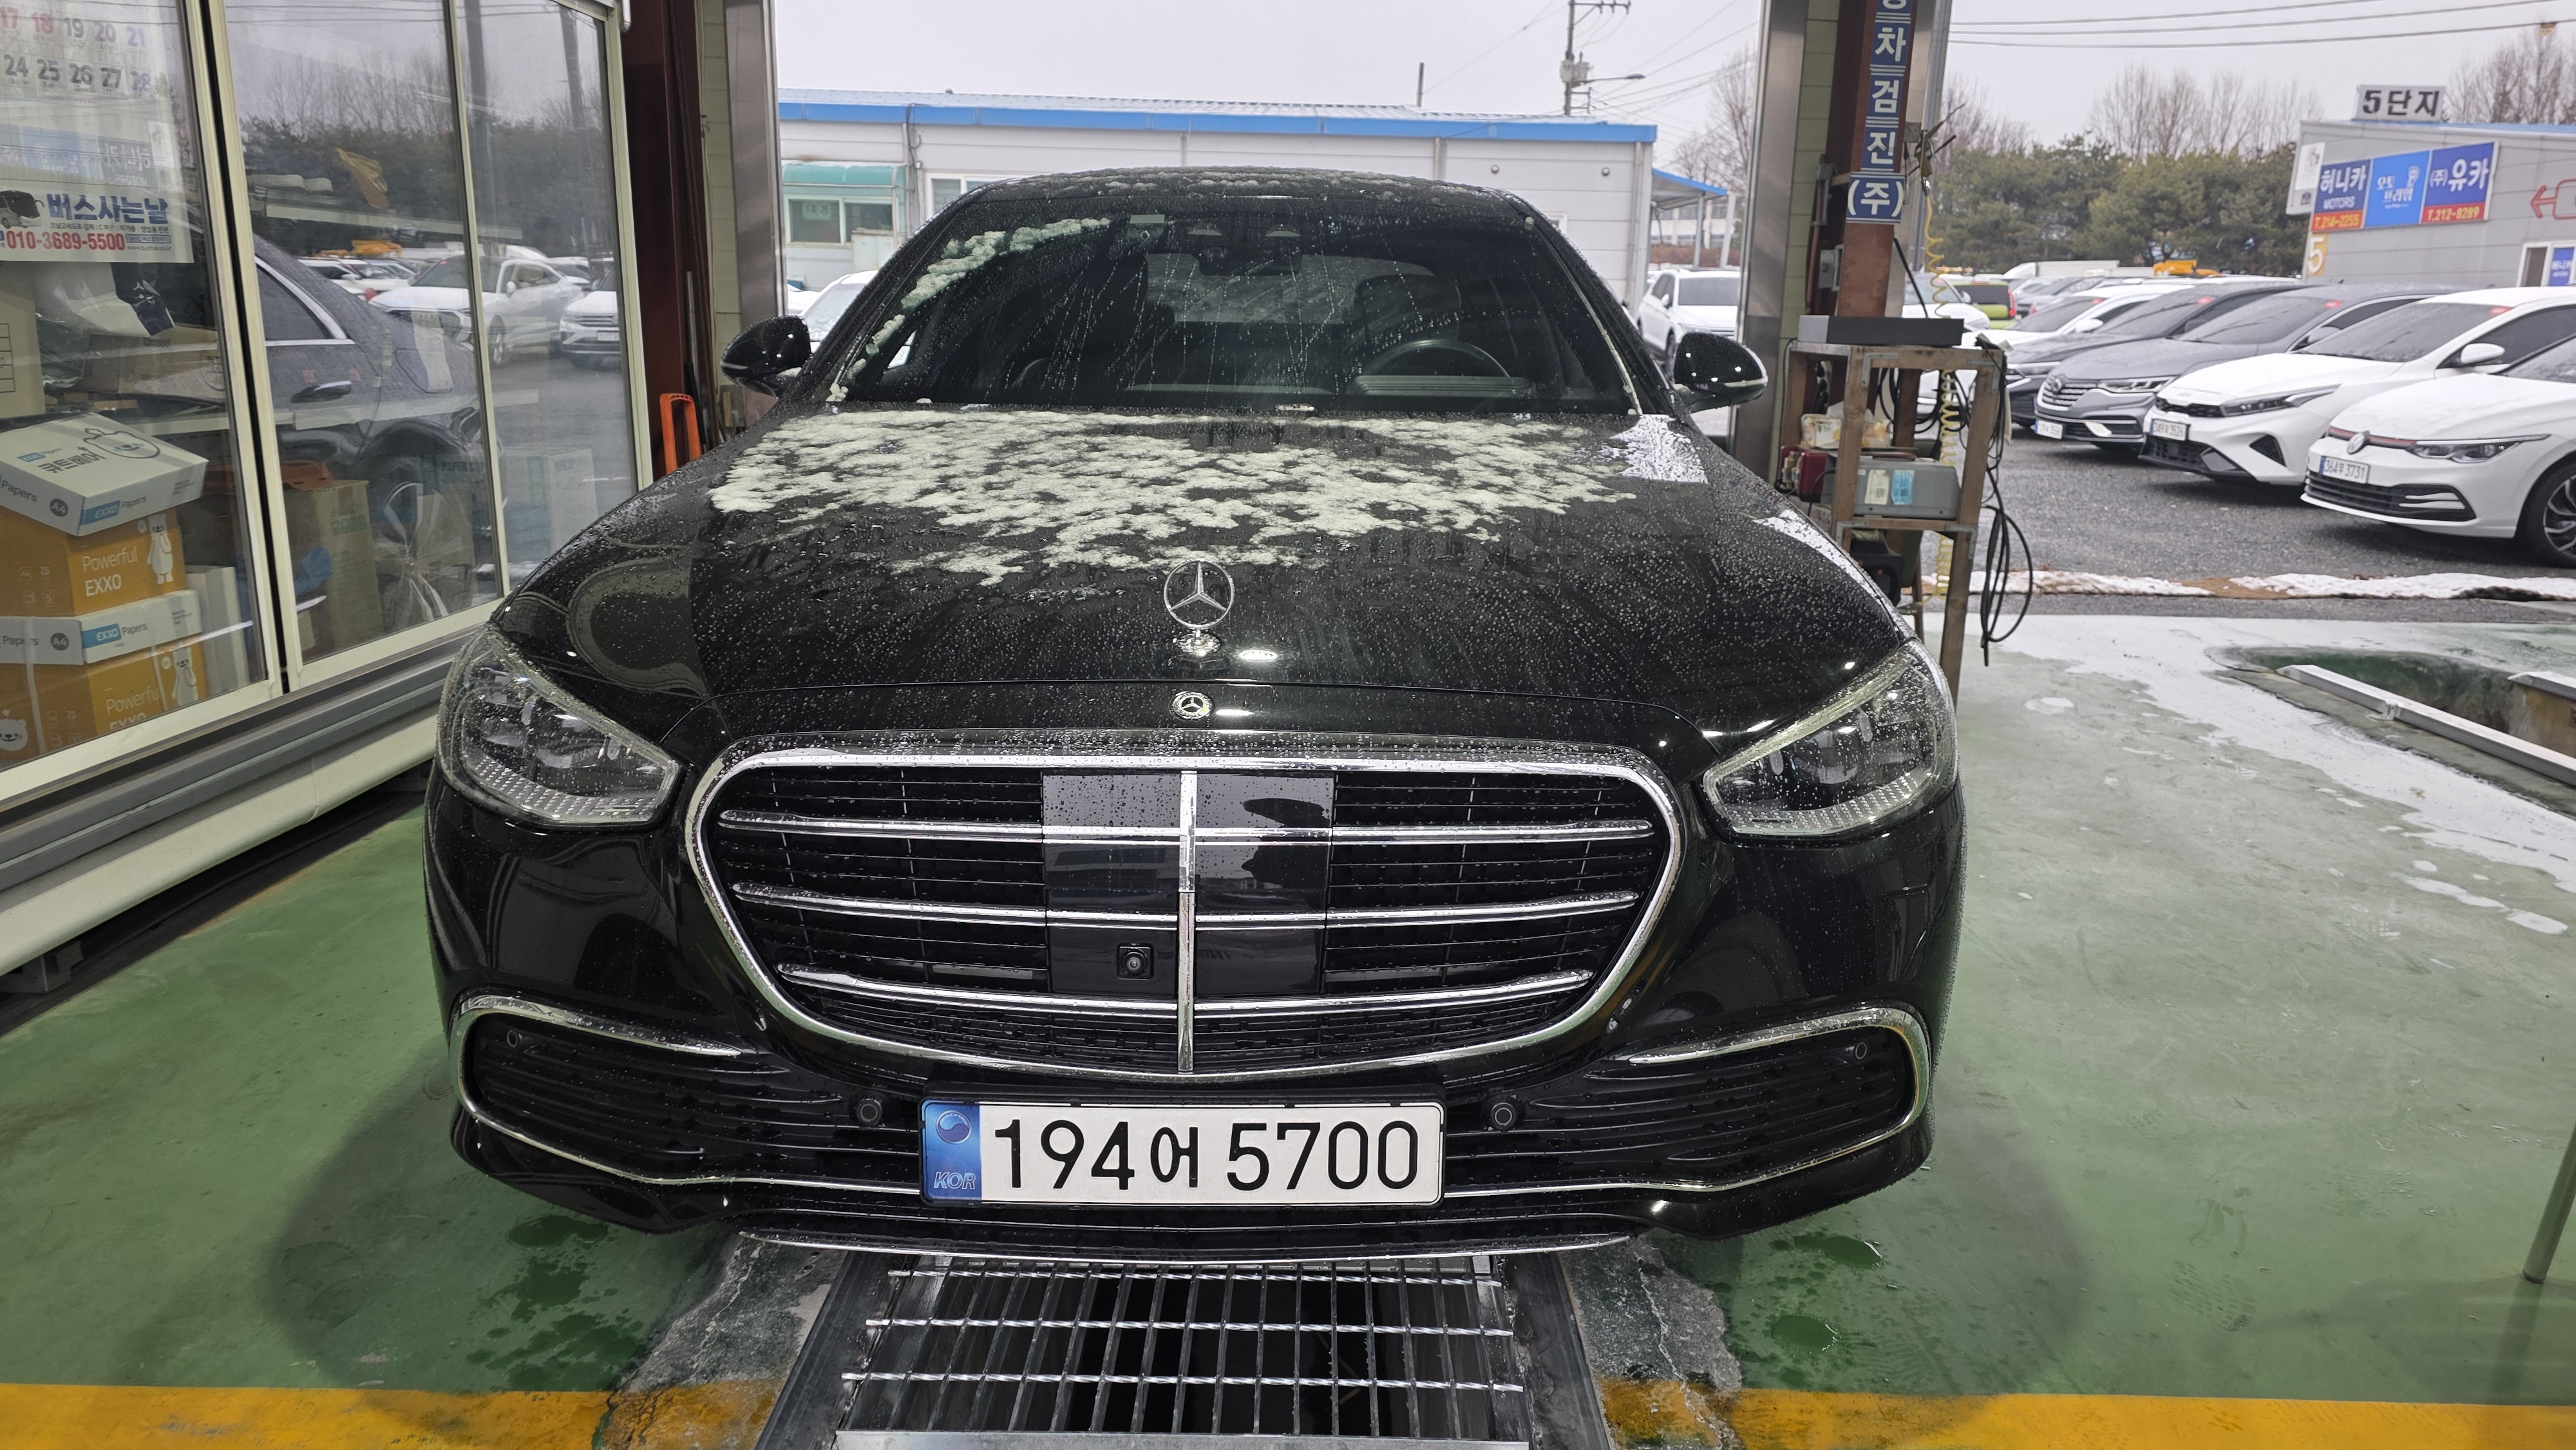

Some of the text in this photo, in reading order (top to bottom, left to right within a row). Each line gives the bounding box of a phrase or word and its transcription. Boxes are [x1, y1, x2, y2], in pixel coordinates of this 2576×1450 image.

[0, 6, 146, 48] 17 18 19 20 21
[4, 54, 152, 92] 24 25 26 27 28
[2362, 89, 2440, 117] 5단지
[2320, 165, 2367, 194] 허니카
[46, 193, 169, 224] 버스사는날
[2323, 196, 2355, 210] MOTORS
[6, 230, 126, 251] 010-3689-5500
[2307, 236, 2324, 274] 5
[1, 479, 37, 502] Papers
[51, 501, 67, 515] A4
[95, 496, 147, 519] EXXO Papers
[82, 545, 138, 573] Powerful
[84, 573, 122, 597] EXXO
[97, 623, 148, 641] EXXO Papers
[106, 685, 161, 715] Powerfu
[995, 1118, 1419, 1191] 194어 5700
[933, 1171, 976, 1190] KOR
